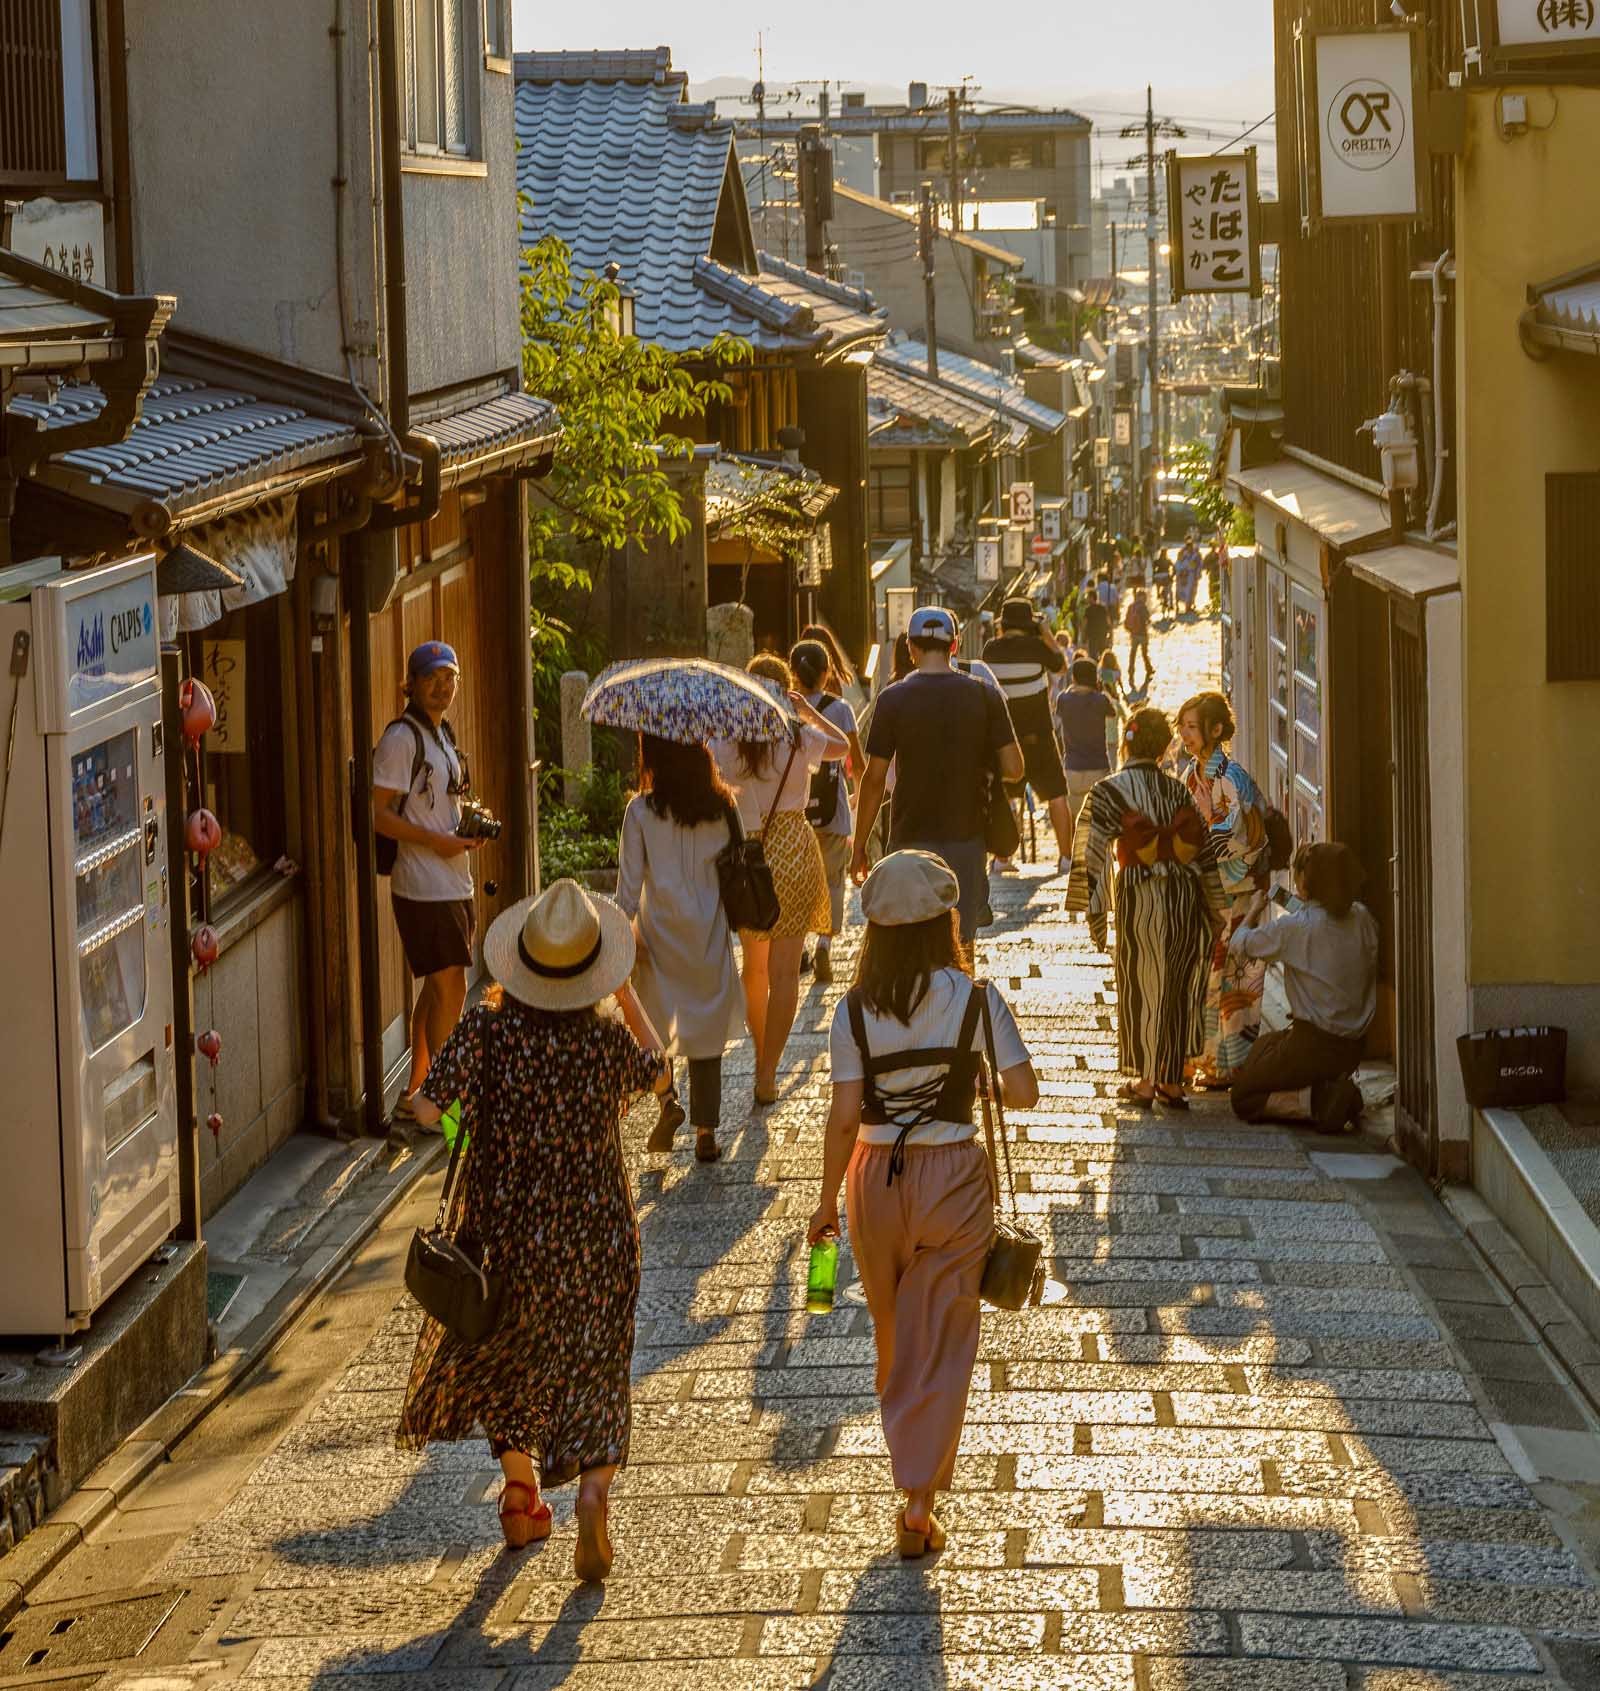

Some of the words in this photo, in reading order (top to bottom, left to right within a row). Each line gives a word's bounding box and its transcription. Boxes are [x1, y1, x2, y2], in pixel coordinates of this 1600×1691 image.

[1342, 138, 1392, 153] ORBITA
[1185, 184, 1209, 271] やさか
[1209, 169, 1244, 282] たばこ
[77, 610, 105, 669] Asahi
[110, 605, 142, 654] CALPIS
